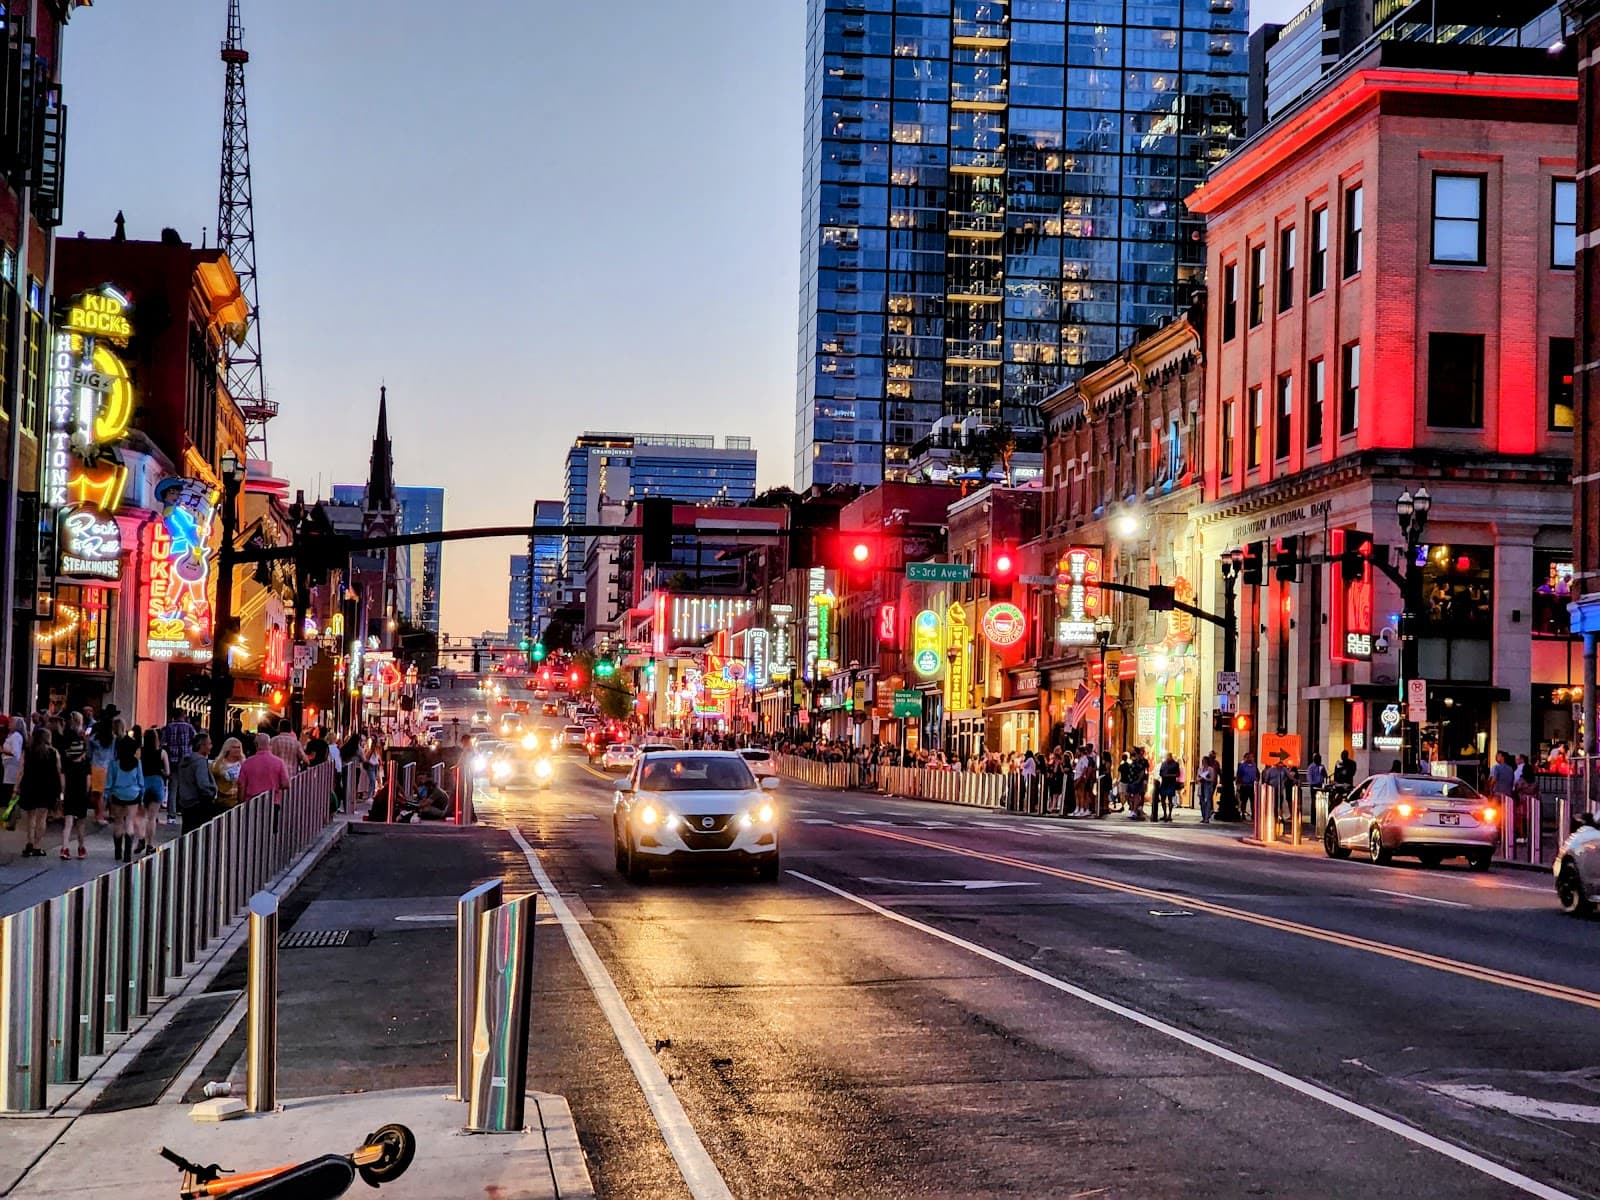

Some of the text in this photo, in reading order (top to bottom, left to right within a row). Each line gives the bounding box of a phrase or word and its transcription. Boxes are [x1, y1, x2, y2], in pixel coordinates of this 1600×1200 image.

[85, 293, 120, 314] KID
[72, 369, 100, 388] BIG
[51, 334, 71, 504] HONKY TONK
[1270, 507, 1306, 528] NATIONAL
[1310, 499, 1332, 517] BANK
[63, 555, 119, 577] STEAKHOUSE
[149, 618, 185, 639] 32
[1347, 633, 1371, 643] OLE
[149, 648, 174, 657] FOOD
[1347, 642, 1371, 655] RED
[1217, 683, 1227, 692] OK
[1265, 738, 1298, 746] DETOUR
[1373, 736, 1403, 746] LOOKOU
